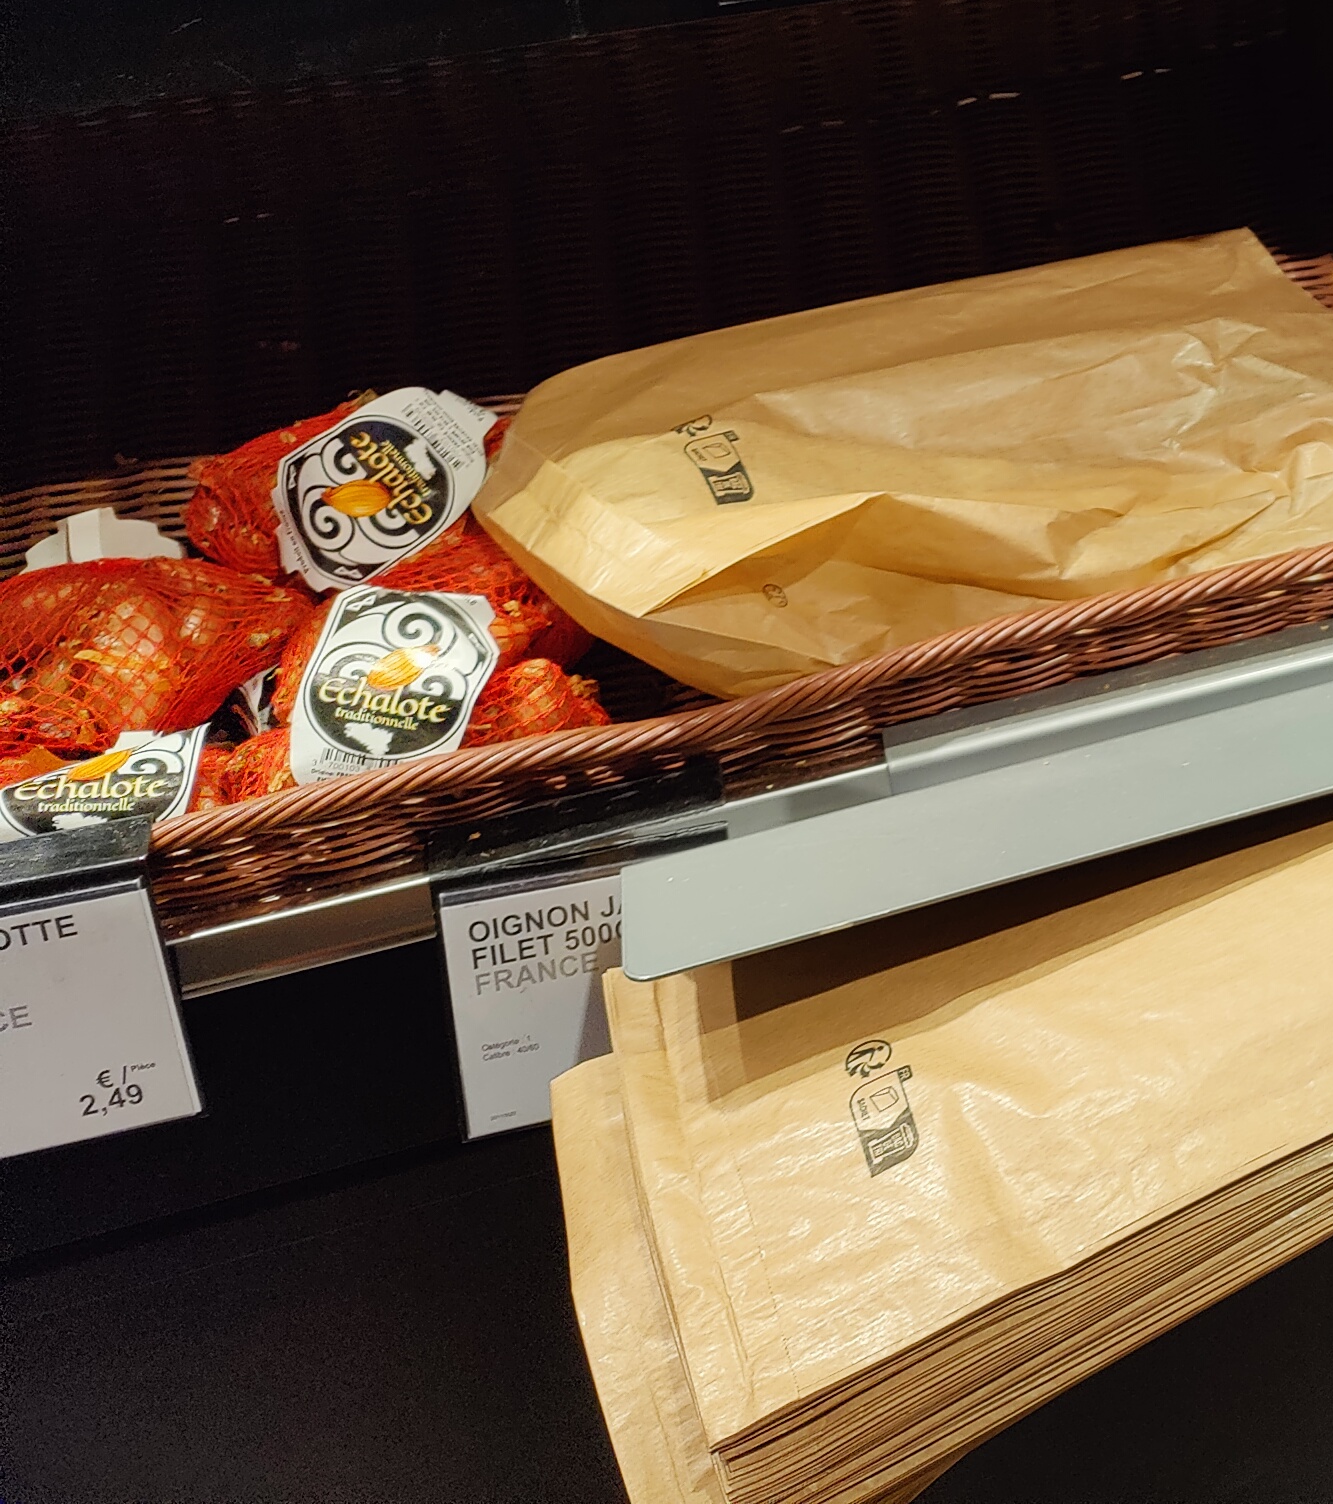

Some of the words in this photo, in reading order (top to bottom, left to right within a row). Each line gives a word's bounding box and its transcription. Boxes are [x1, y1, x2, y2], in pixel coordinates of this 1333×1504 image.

[319, 678, 453, 724] Echalote
[334, 704, 419, 731] traditionnelle
[14, 772, 170, 801] Echalote
[37, 798, 136, 813] traditionnelle
[469, 900, 590, 942] OIGNON
[472, 933, 553, 970] FILET
[475, 951, 598, 995] FRANCE
[80, 1083, 143, 1116] 2,49
